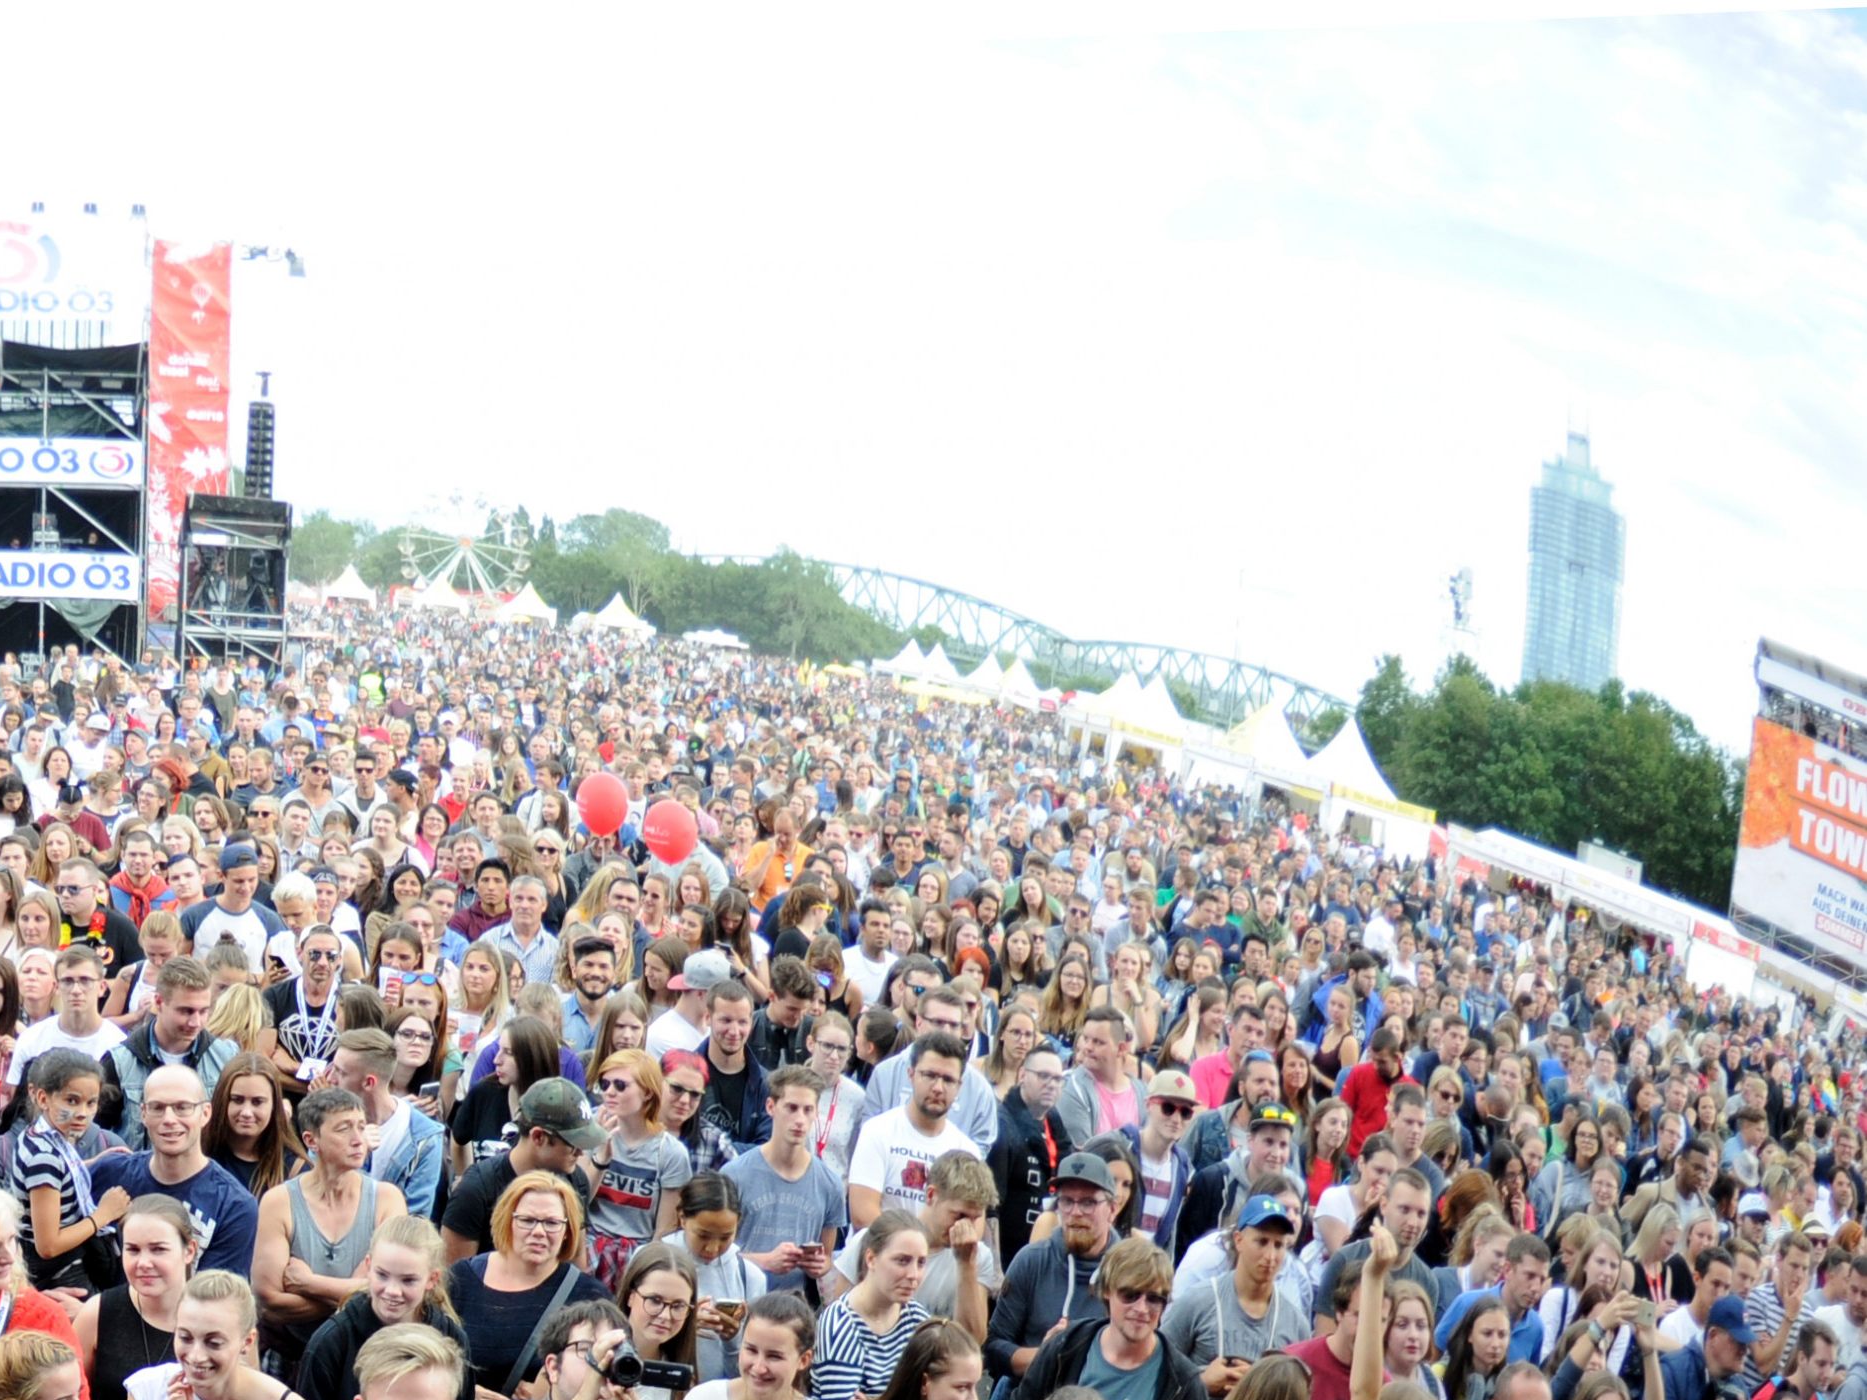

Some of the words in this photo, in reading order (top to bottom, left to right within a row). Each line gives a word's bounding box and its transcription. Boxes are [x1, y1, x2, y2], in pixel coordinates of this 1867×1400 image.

[67, 284, 114, 313] Ö3
[32, 439, 79, 473] Ö3
[84, 556, 130, 590] Ö3
[1798, 808, 1867, 876] TOW
[1812, 896, 1831, 915] AUS
[1817, 883, 1846, 904] MACH
[1817, 916, 1864, 946] SOMMER
